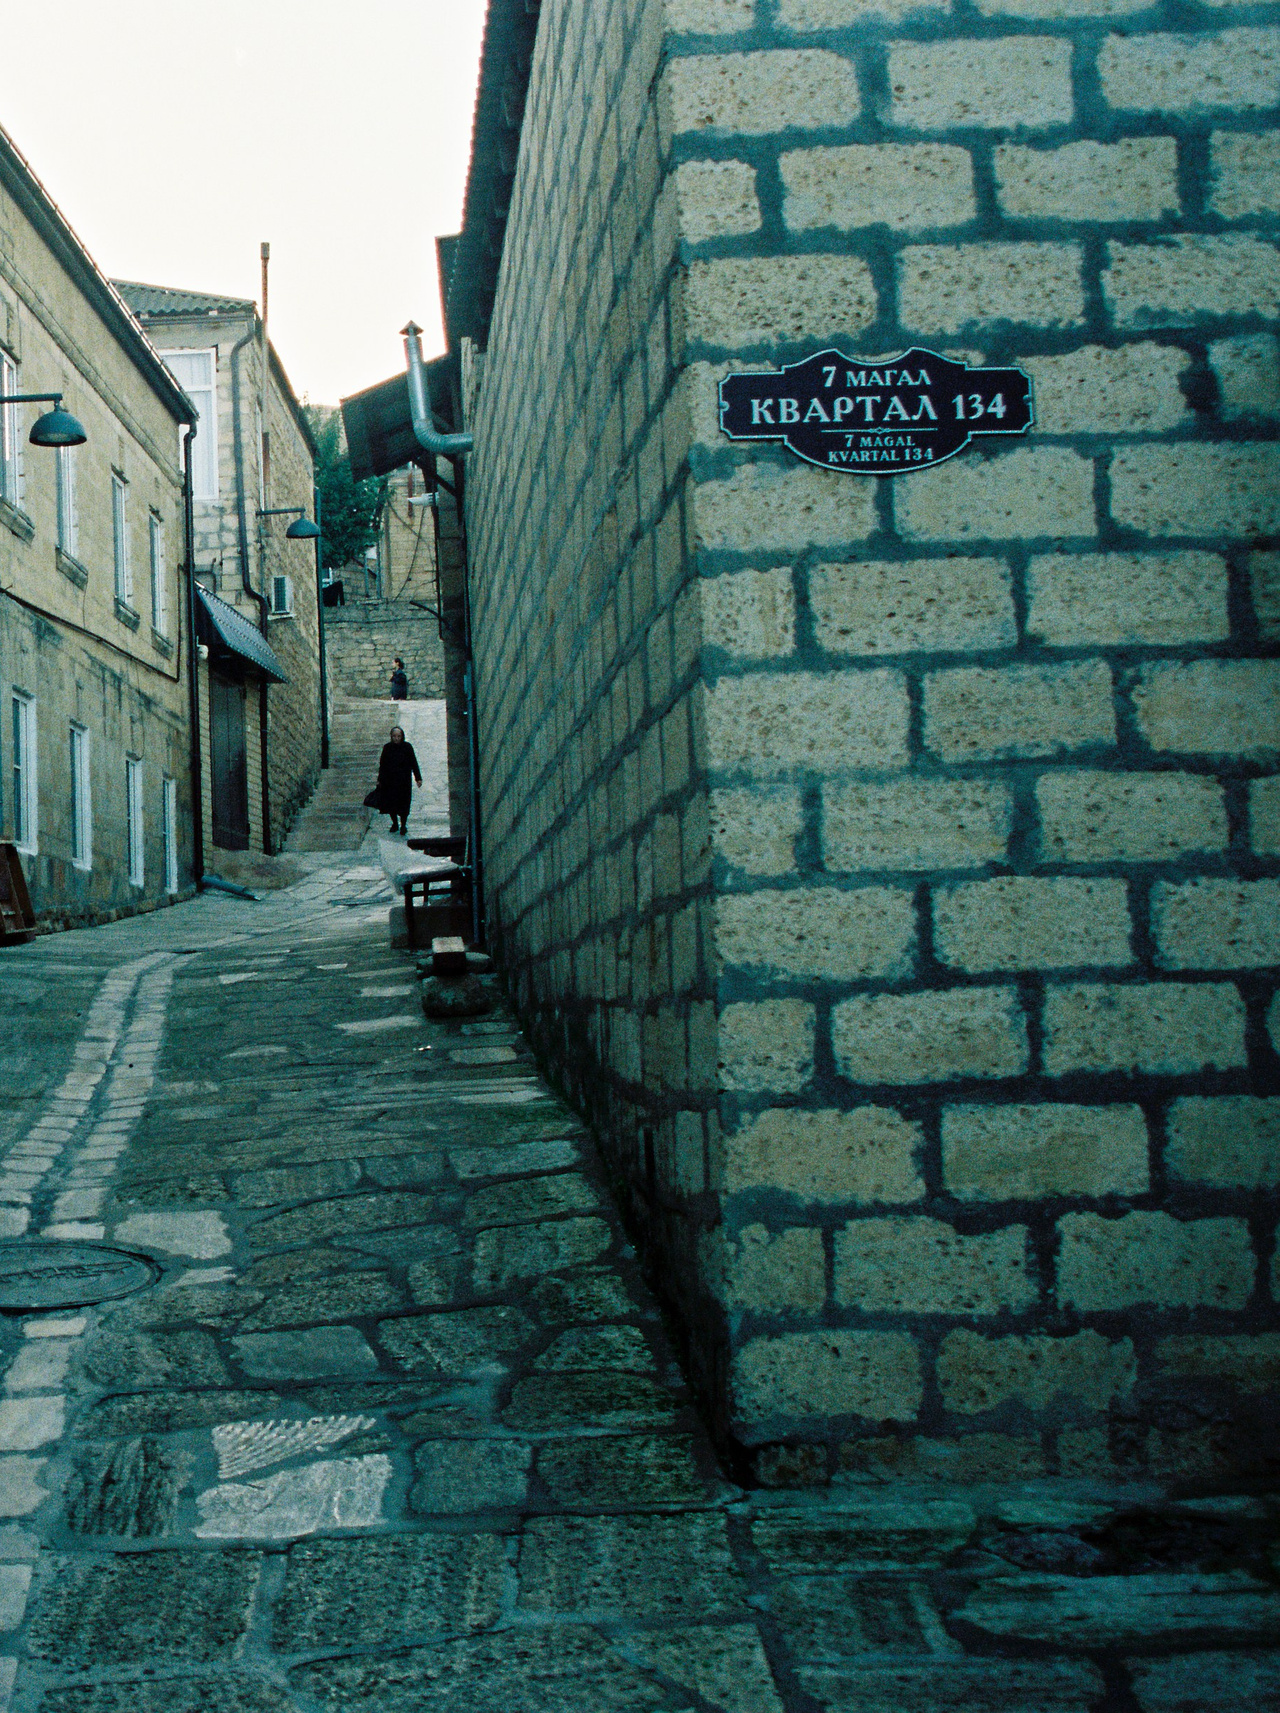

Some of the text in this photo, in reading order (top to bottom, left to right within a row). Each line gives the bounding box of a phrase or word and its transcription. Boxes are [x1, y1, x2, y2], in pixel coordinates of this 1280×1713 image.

[822, 366, 932, 388] 7 МАГАЛ
[750, 393, 1008, 425] КВАРТАЛ 134
[845, 435, 915, 448] 7 MAGAL
[828, 448, 934, 463] KVARTAL 134
